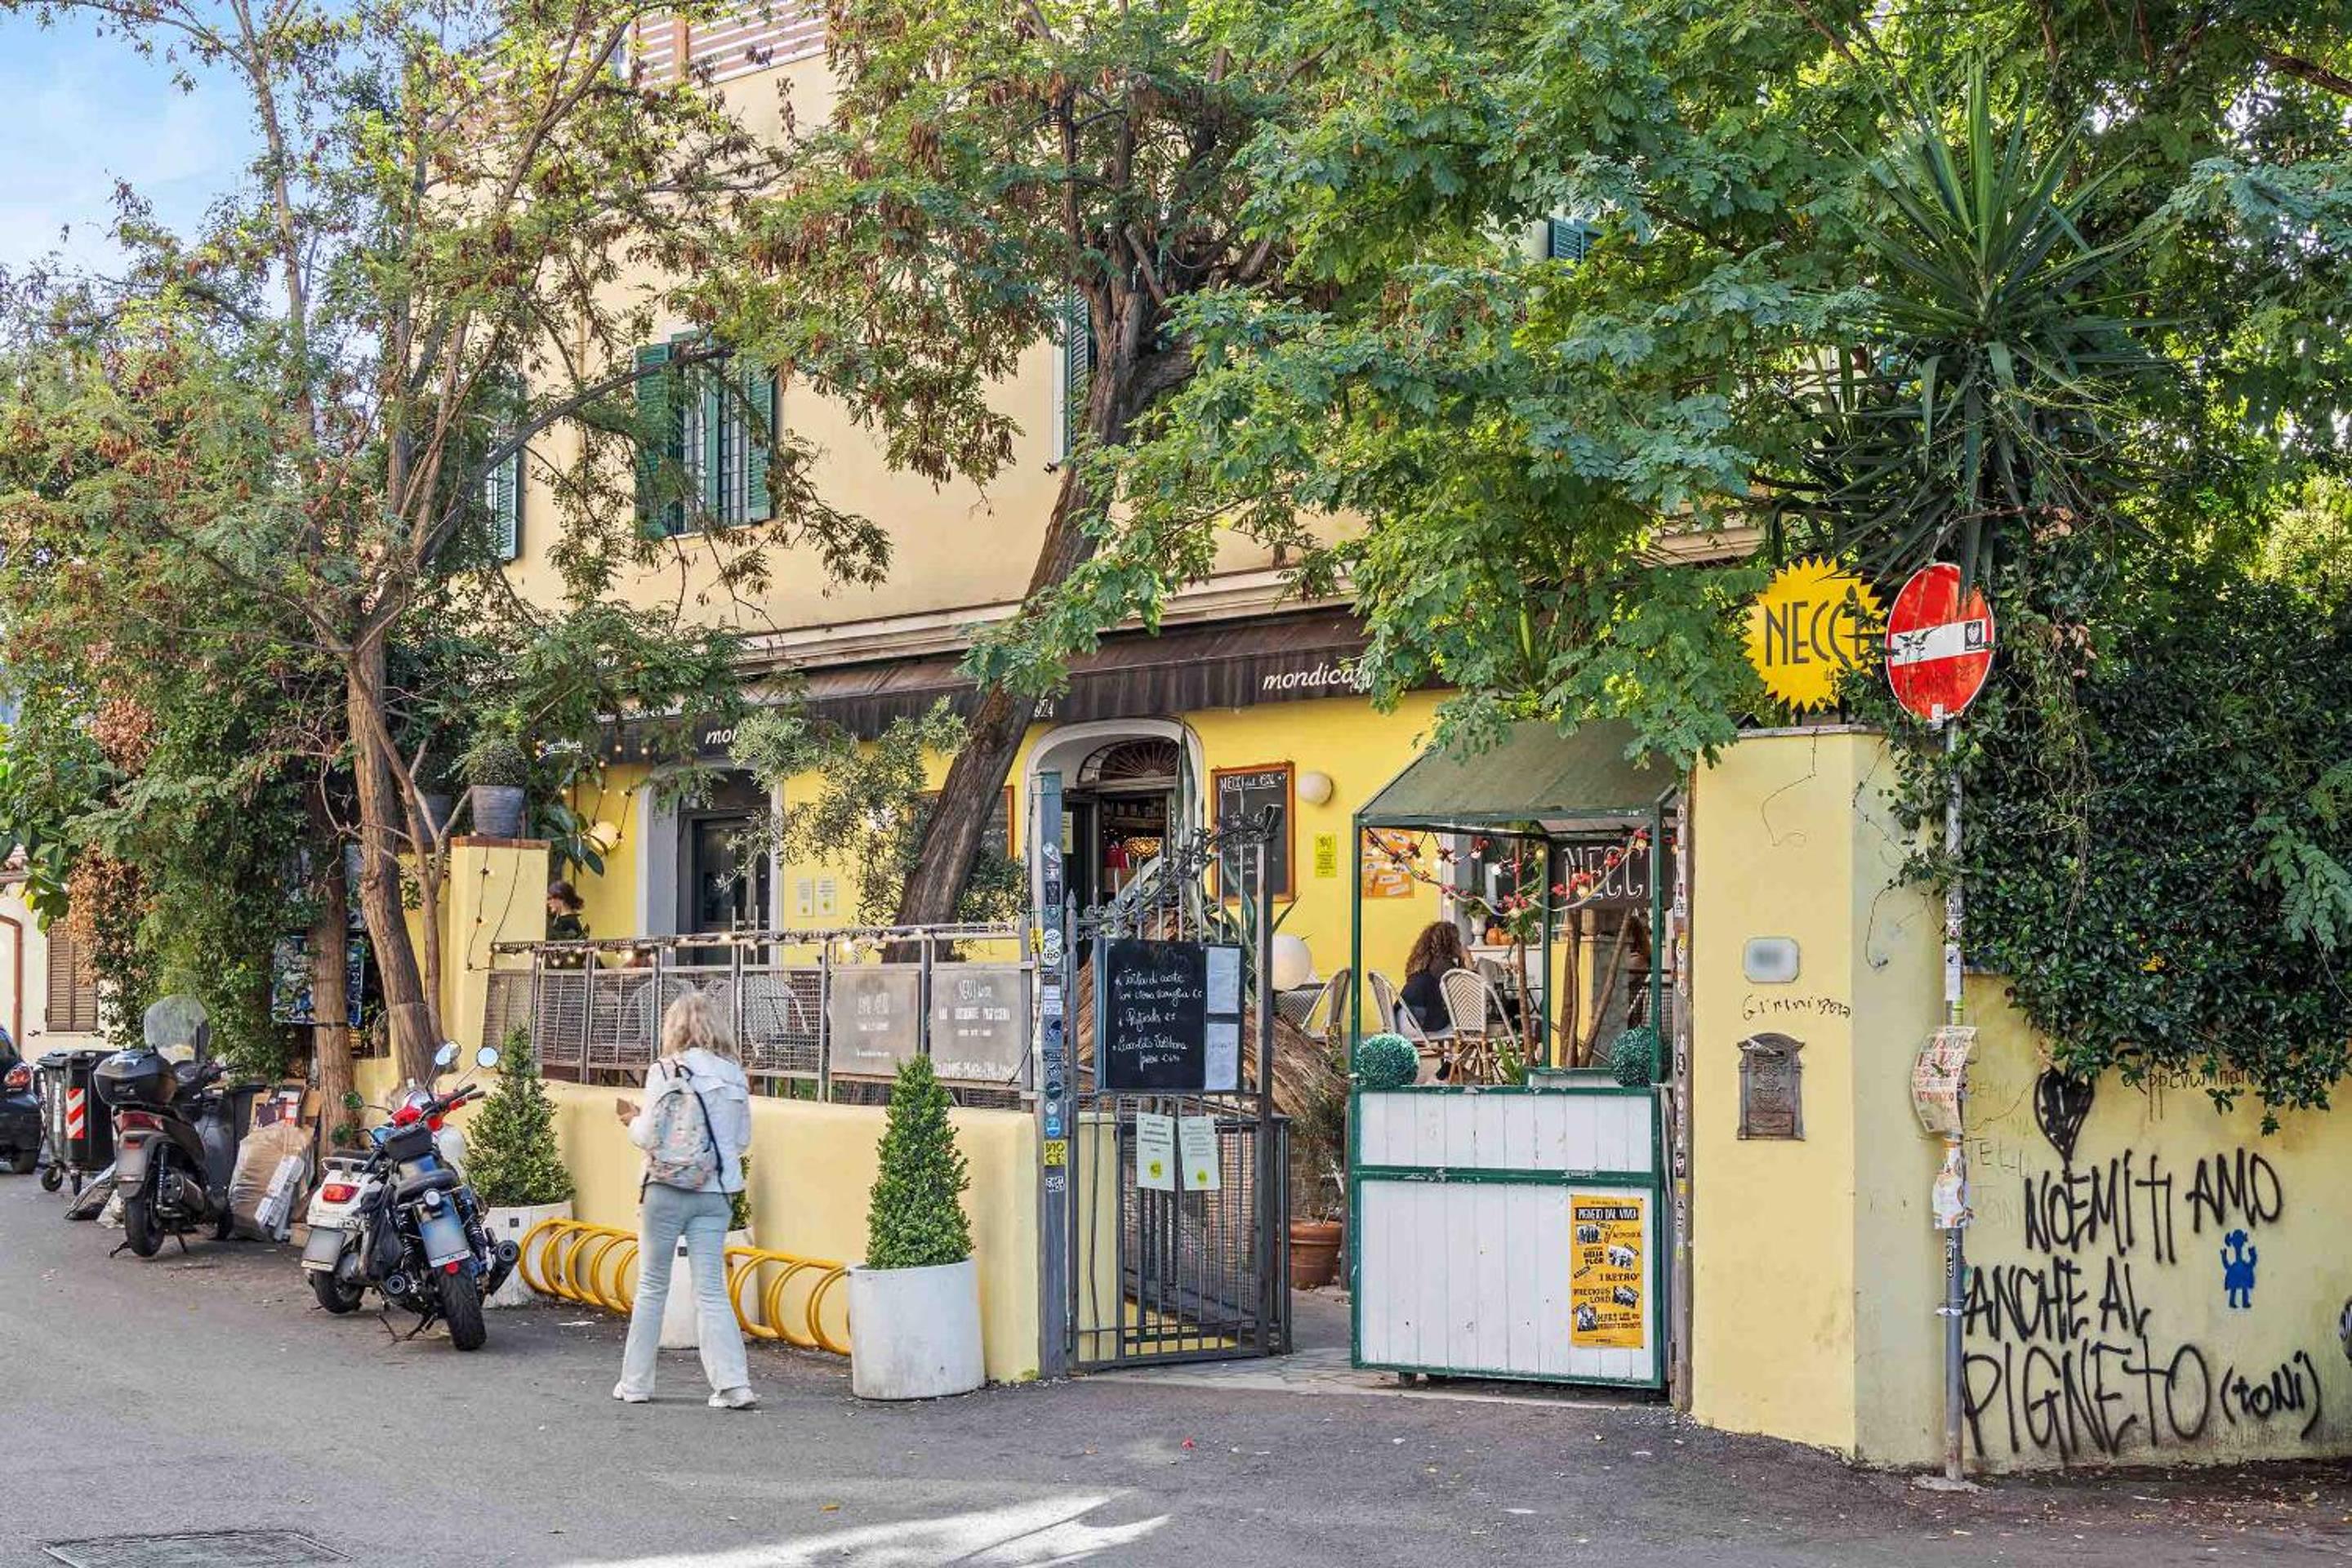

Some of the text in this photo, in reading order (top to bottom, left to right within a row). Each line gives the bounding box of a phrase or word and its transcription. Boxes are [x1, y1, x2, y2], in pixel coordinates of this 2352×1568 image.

[2185, 1147, 2284, 1234] AMO
[1962, 1255, 2090, 1343] ANCHE
[2097, 1256, 2151, 1339] AL
[1962, 1334, 2208, 1463] PIGNETO
